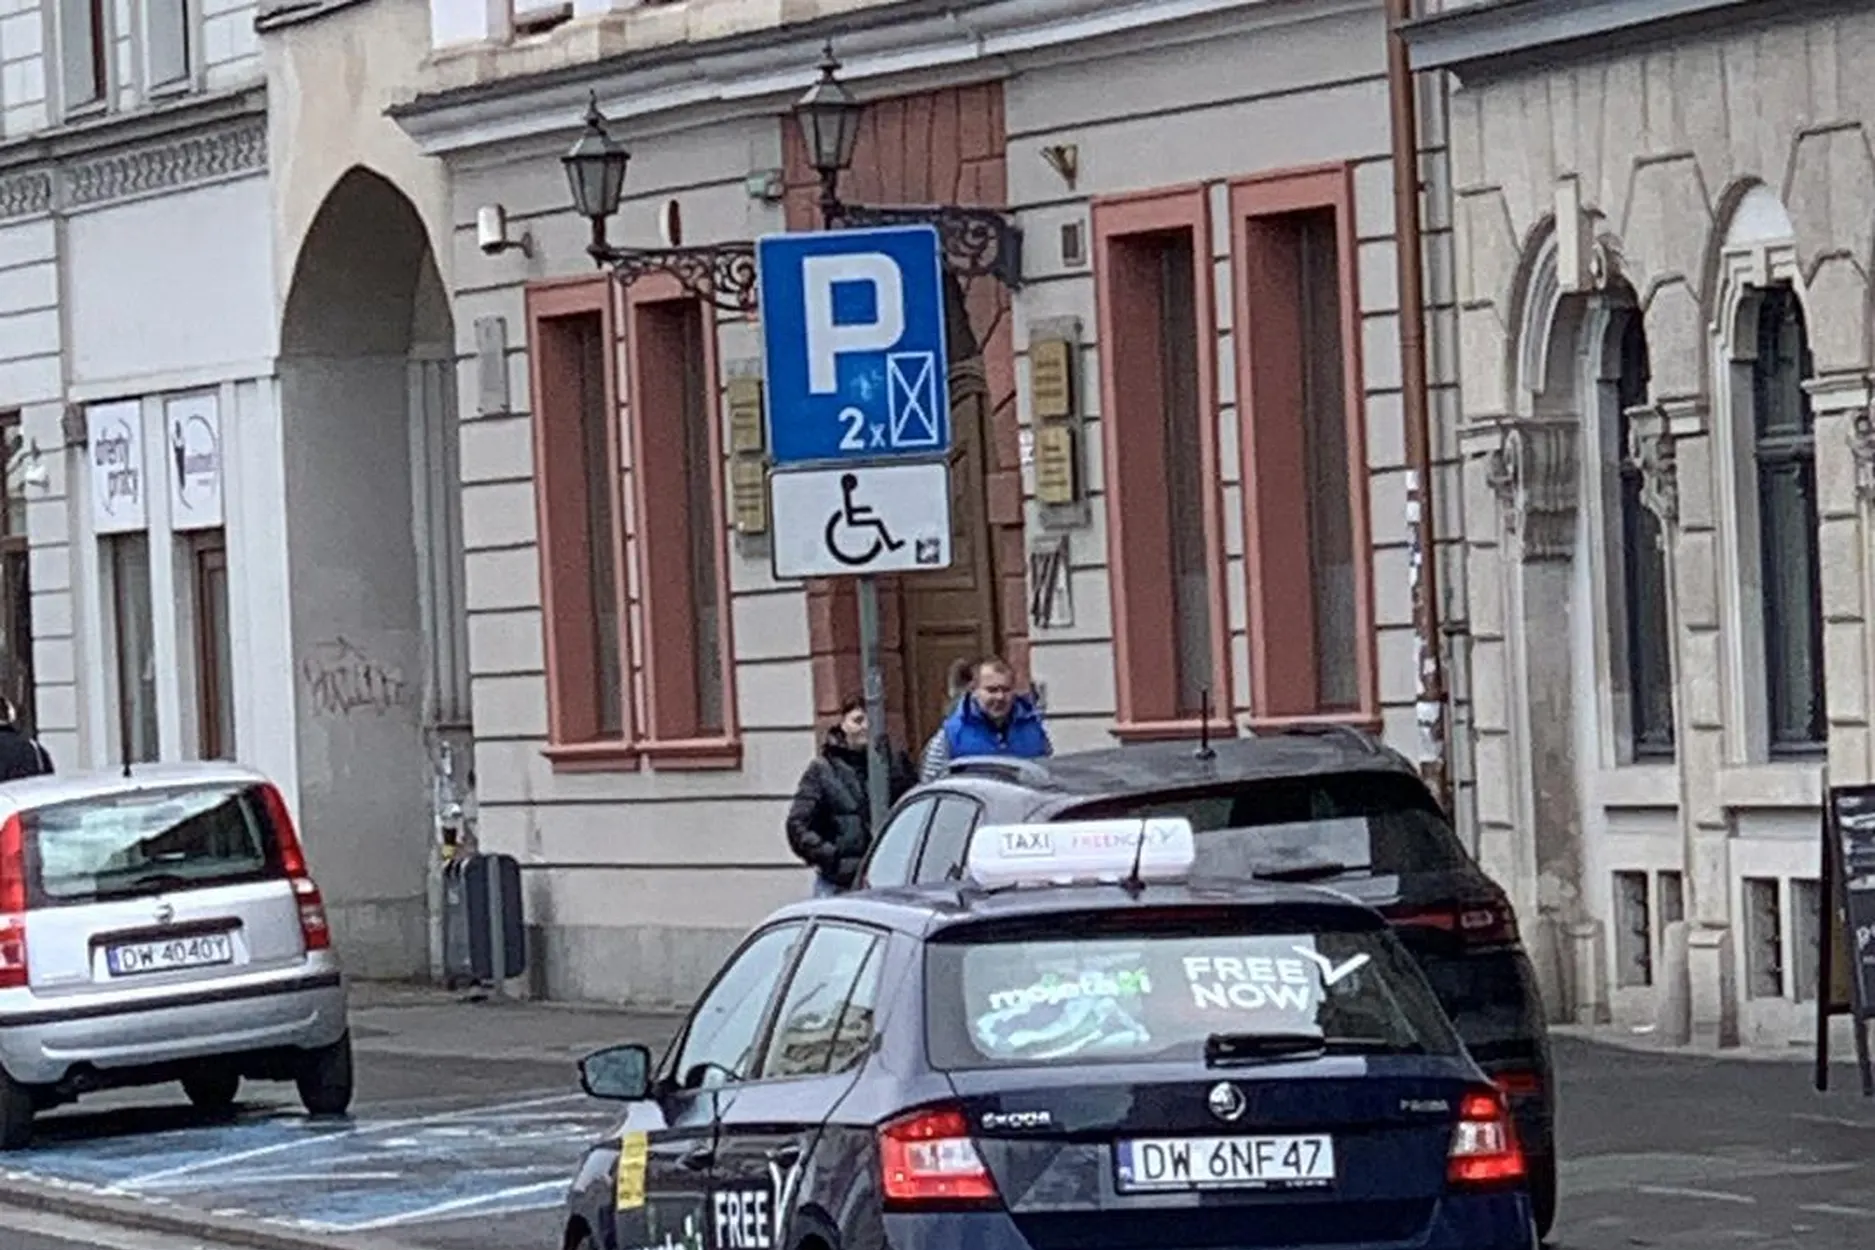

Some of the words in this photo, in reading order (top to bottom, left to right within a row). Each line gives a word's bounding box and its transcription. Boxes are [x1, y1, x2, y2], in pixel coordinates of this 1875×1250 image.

[803, 252, 905, 394] P
[1003, 832, 1049, 850] TAXI
[1183, 956, 1308, 985] FREE
[1192, 983, 1309, 1010] NOW
[1142, 1142, 1190, 1179] DW
[1208, 1139, 1321, 1177] 6NF47
[714, 1190, 770, 1249] FREE
